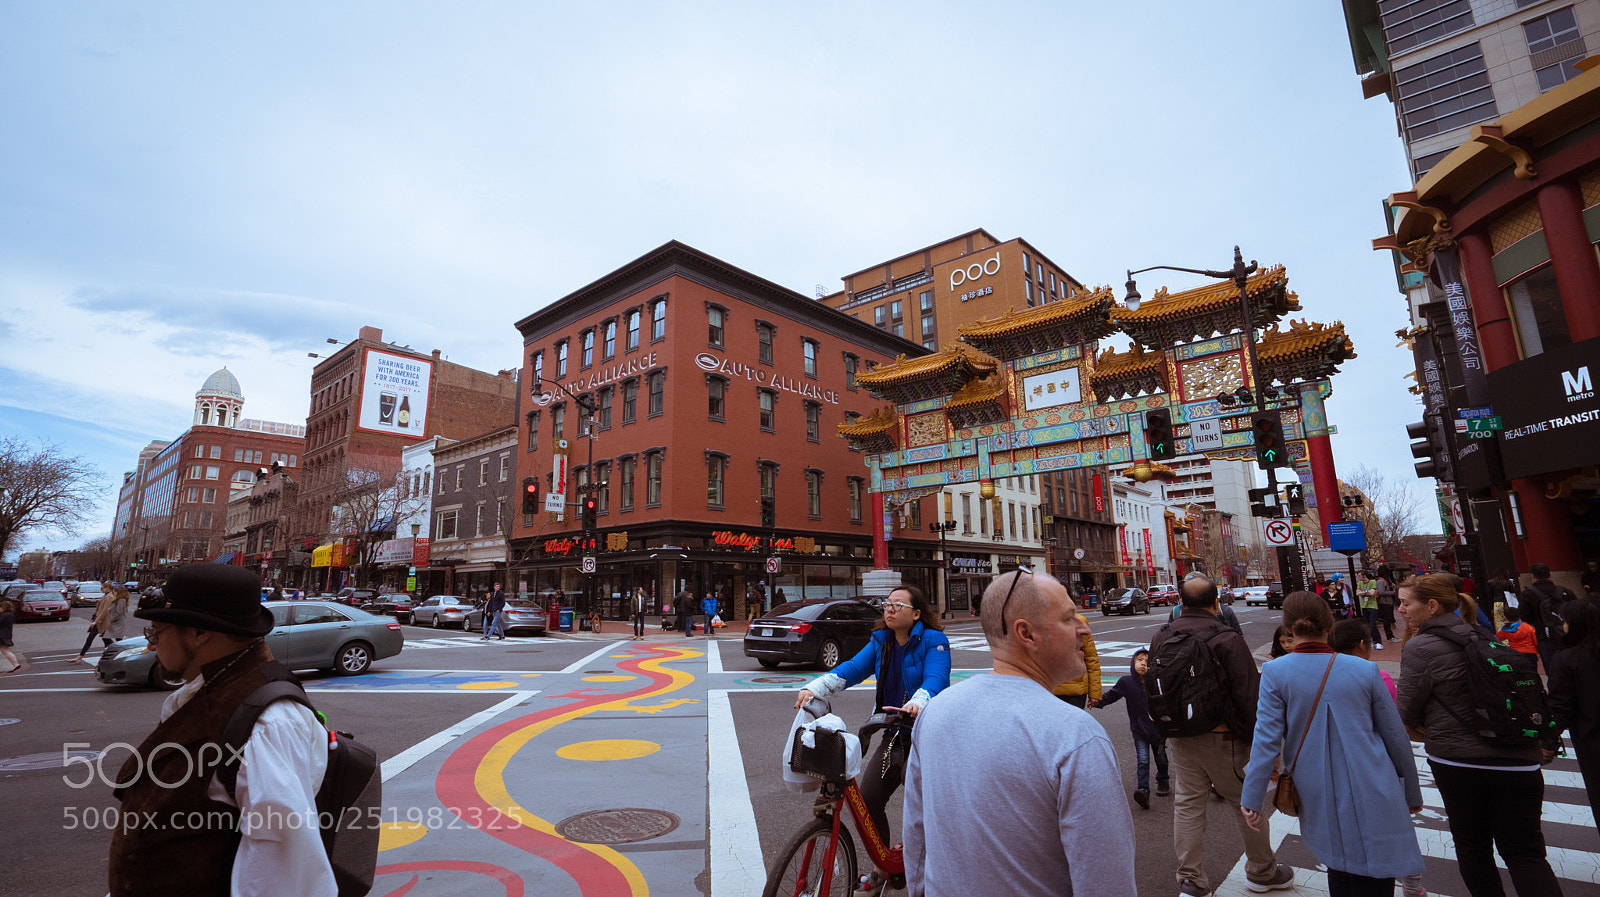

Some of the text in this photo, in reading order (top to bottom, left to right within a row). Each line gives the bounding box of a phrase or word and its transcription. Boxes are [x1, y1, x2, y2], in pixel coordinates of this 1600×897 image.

[950, 251, 1000, 291] pod
[1445, 282, 1480, 370] 美國娛樂公司
[377, 366, 420, 380] WITH AMERICA
[378, 359, 421, 373] SHARING BEER
[375, 373, 387, 382] FOR
[388, 376, 400, 385] 200
[552, 352, 657, 402] AUTO ALLIANCE
[719, 358, 840, 405] AUTO ALLIANCE
[1561, 366, 1593, 396] M
[1567, 391, 1595, 403] metro
[1199, 422, 1211, 431] NO
[1472, 419, 1482, 430] 7
[1504, 409, 1600, 441] REAL-TIME TRANSIT
[1195, 433, 1219, 443] TURNS
[1468, 430, 1492, 439] 700
[712, 531, 793, 550] Walgrns
[1295, 530, 1304, 554] Gallery
[848, 785, 868, 818] capital
